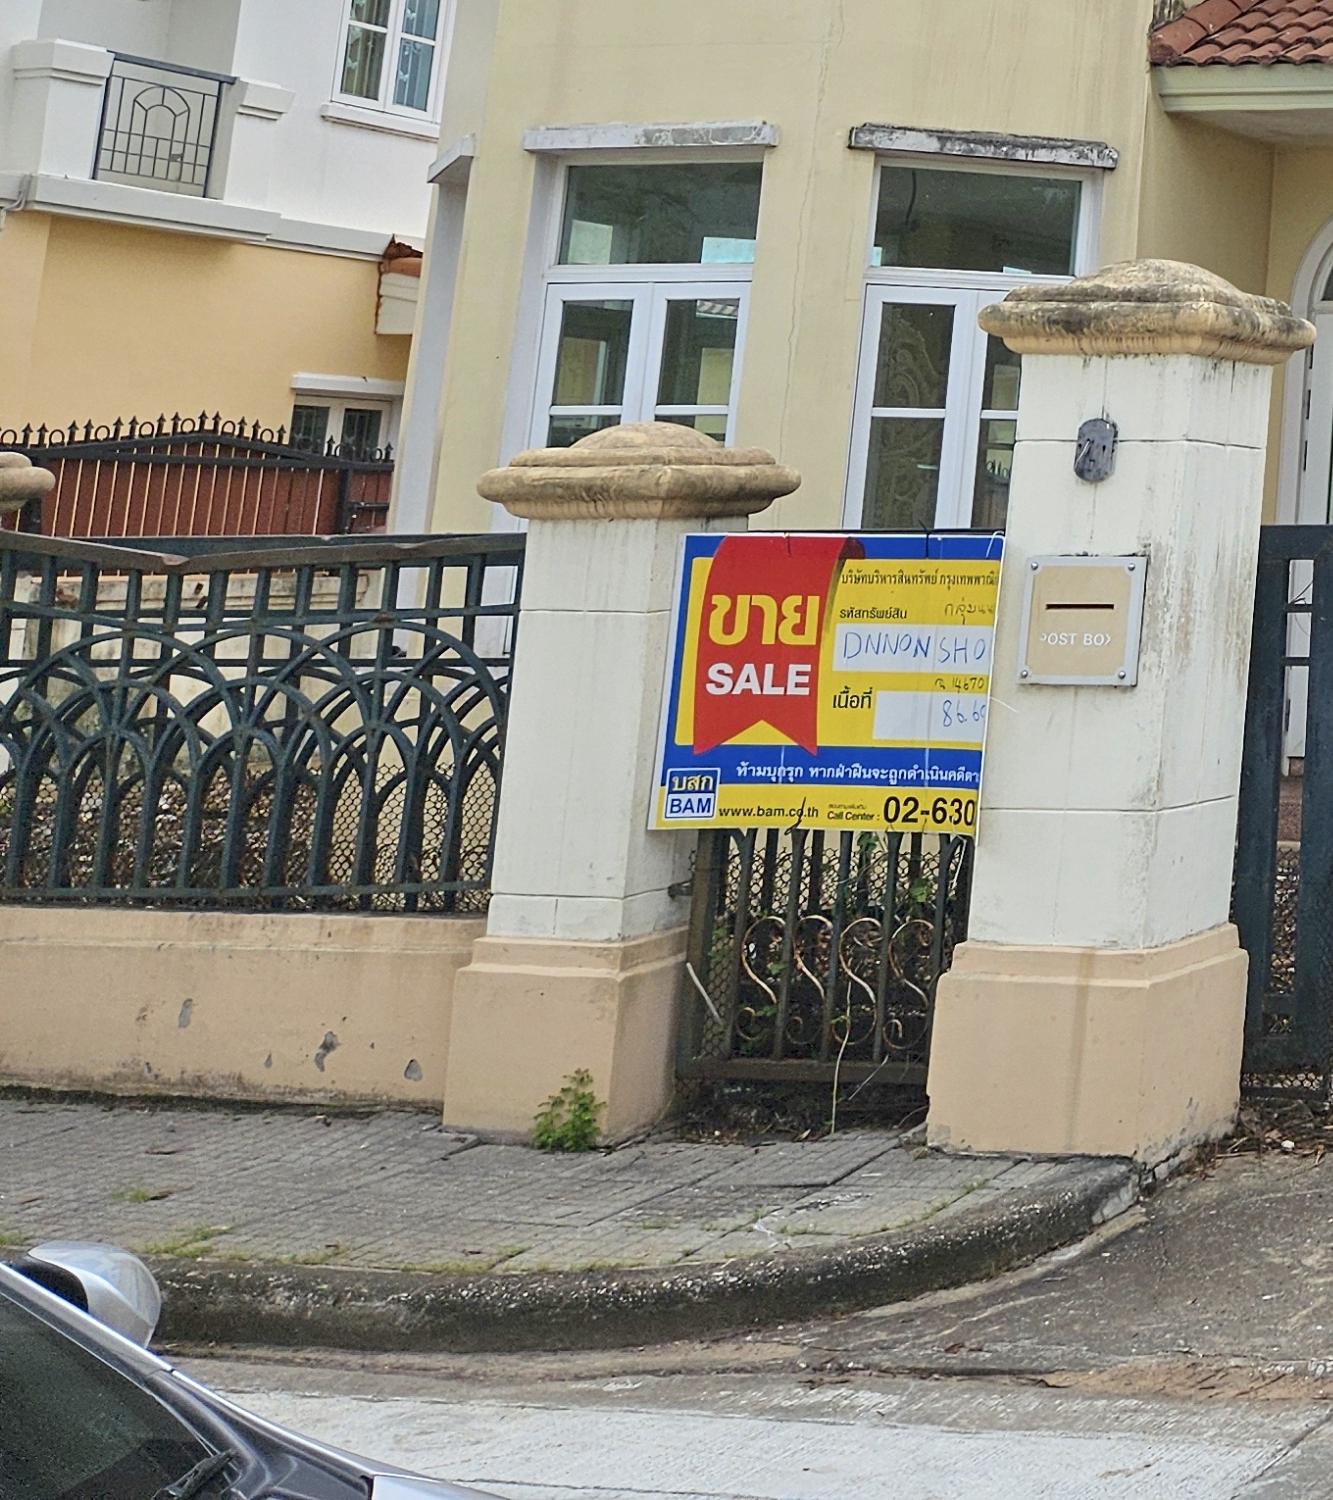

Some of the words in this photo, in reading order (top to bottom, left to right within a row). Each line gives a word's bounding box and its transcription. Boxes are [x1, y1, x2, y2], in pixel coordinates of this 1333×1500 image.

[939, 571, 998, 591] กรุงเทพพาณิ
[708, 594, 820, 645] ขาย
[839, 606, 907, 619] รหัสทรัพย์สิน
[705, 663, 811, 695] SALE
[832, 685, 873, 709] เนื้อที่
[736, 761, 803, 782] ห้ามบุกรุก
[672, 775, 714, 791] บสก
[670, 798, 711, 814] BAM
[718, 805, 819, 818] www.bam.co.th
[827, 811, 843, 820] Call
[884, 796, 975, 826] 02-630
